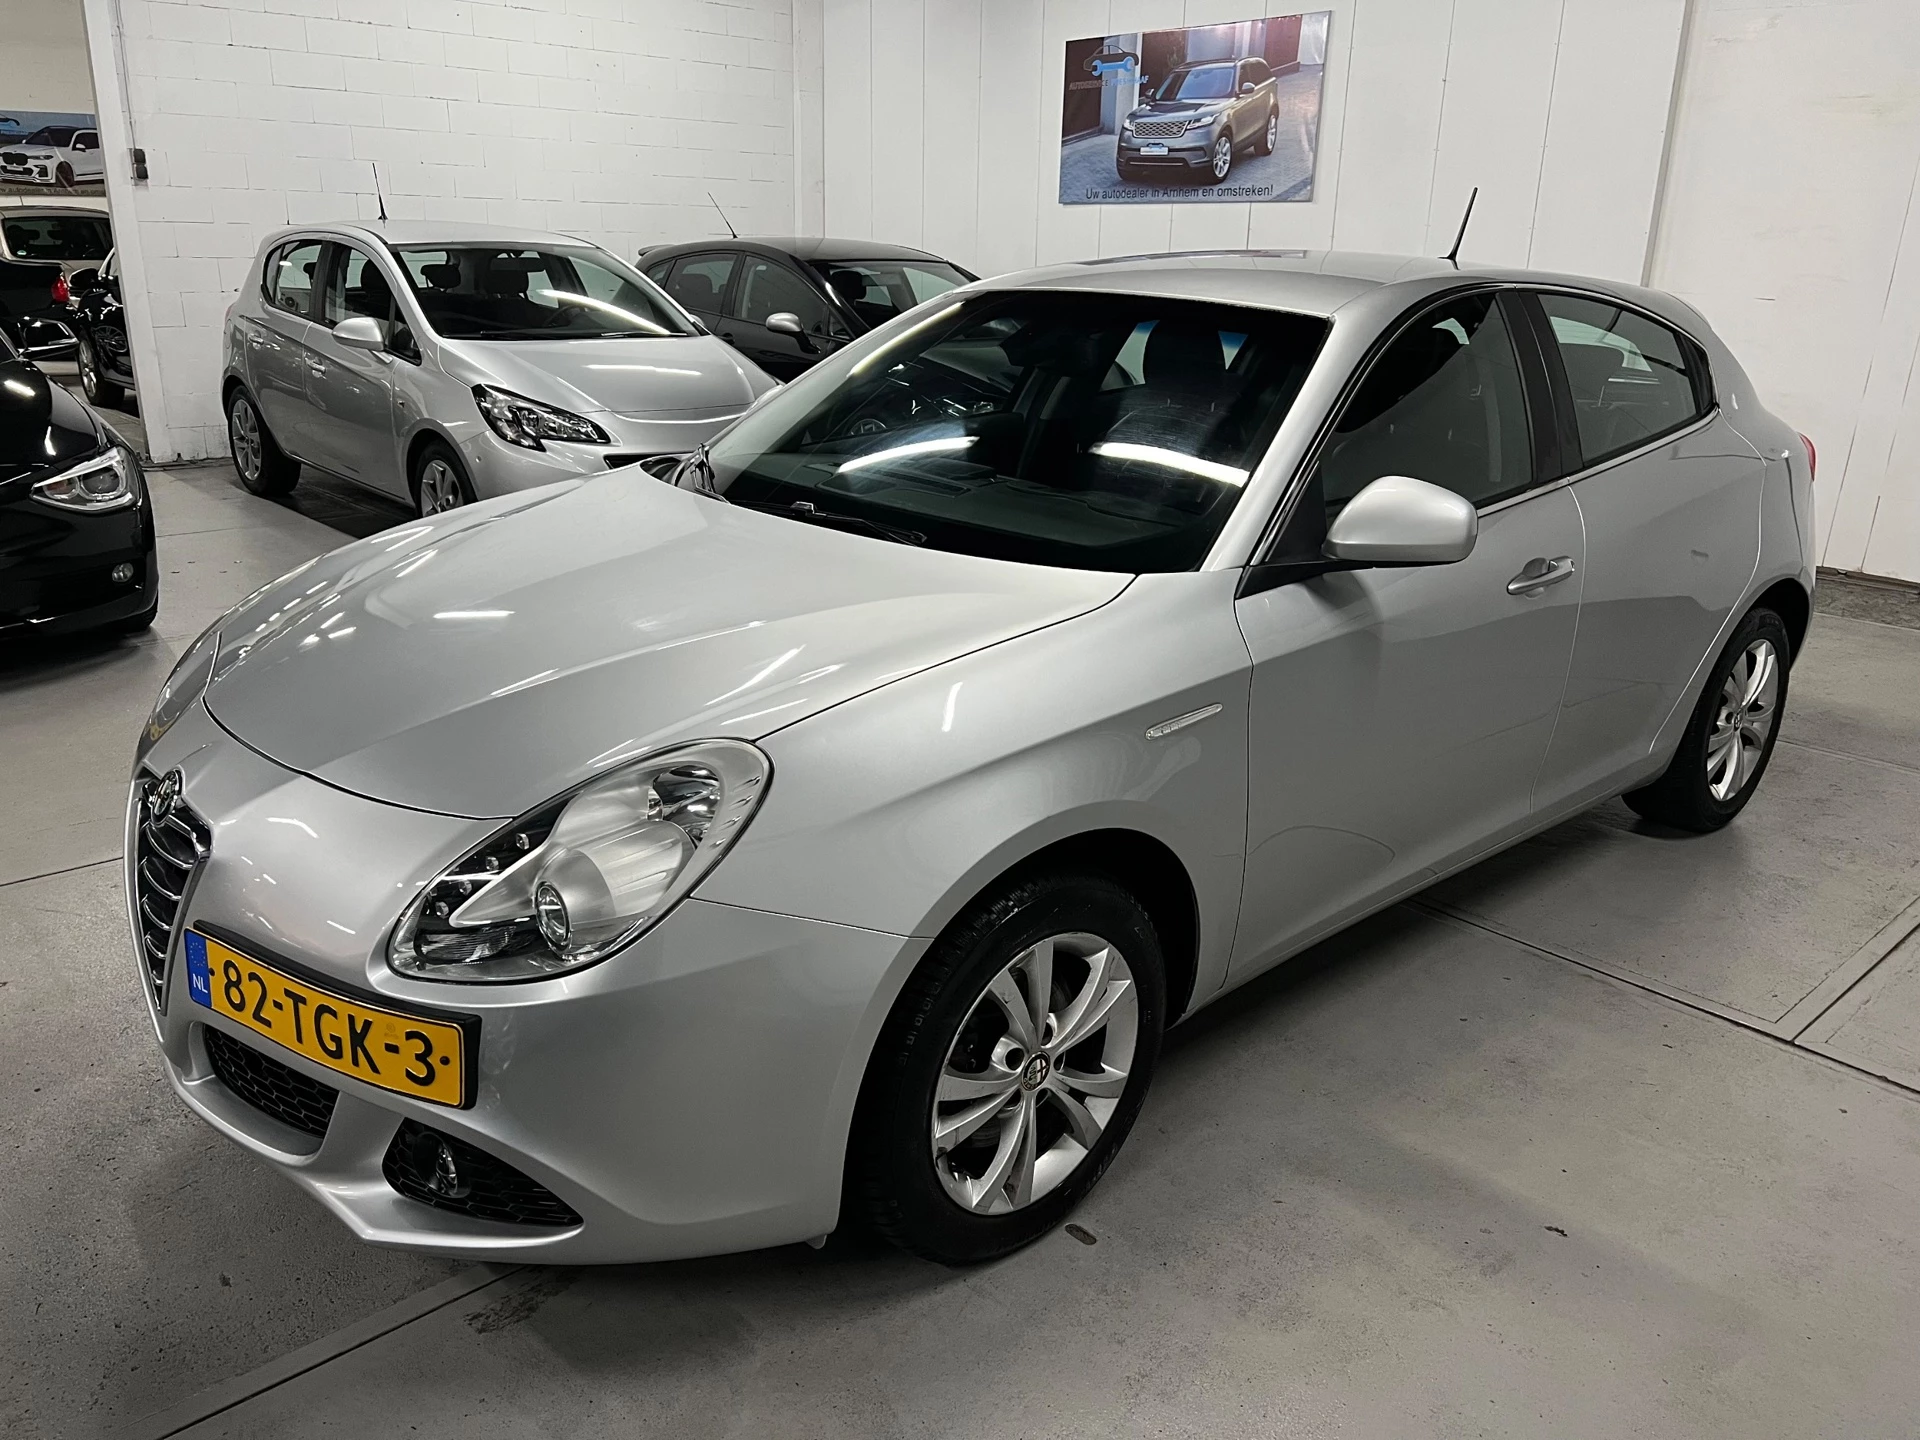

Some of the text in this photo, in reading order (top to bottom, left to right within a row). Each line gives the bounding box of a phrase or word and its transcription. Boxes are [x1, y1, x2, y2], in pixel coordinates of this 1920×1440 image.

[1086, 184, 1273, 199] Uw autodealer in Arnhem en omstreken!
[192, 973, 208, 993] NL
[223, 959, 436, 1087] 82-TGK-3
